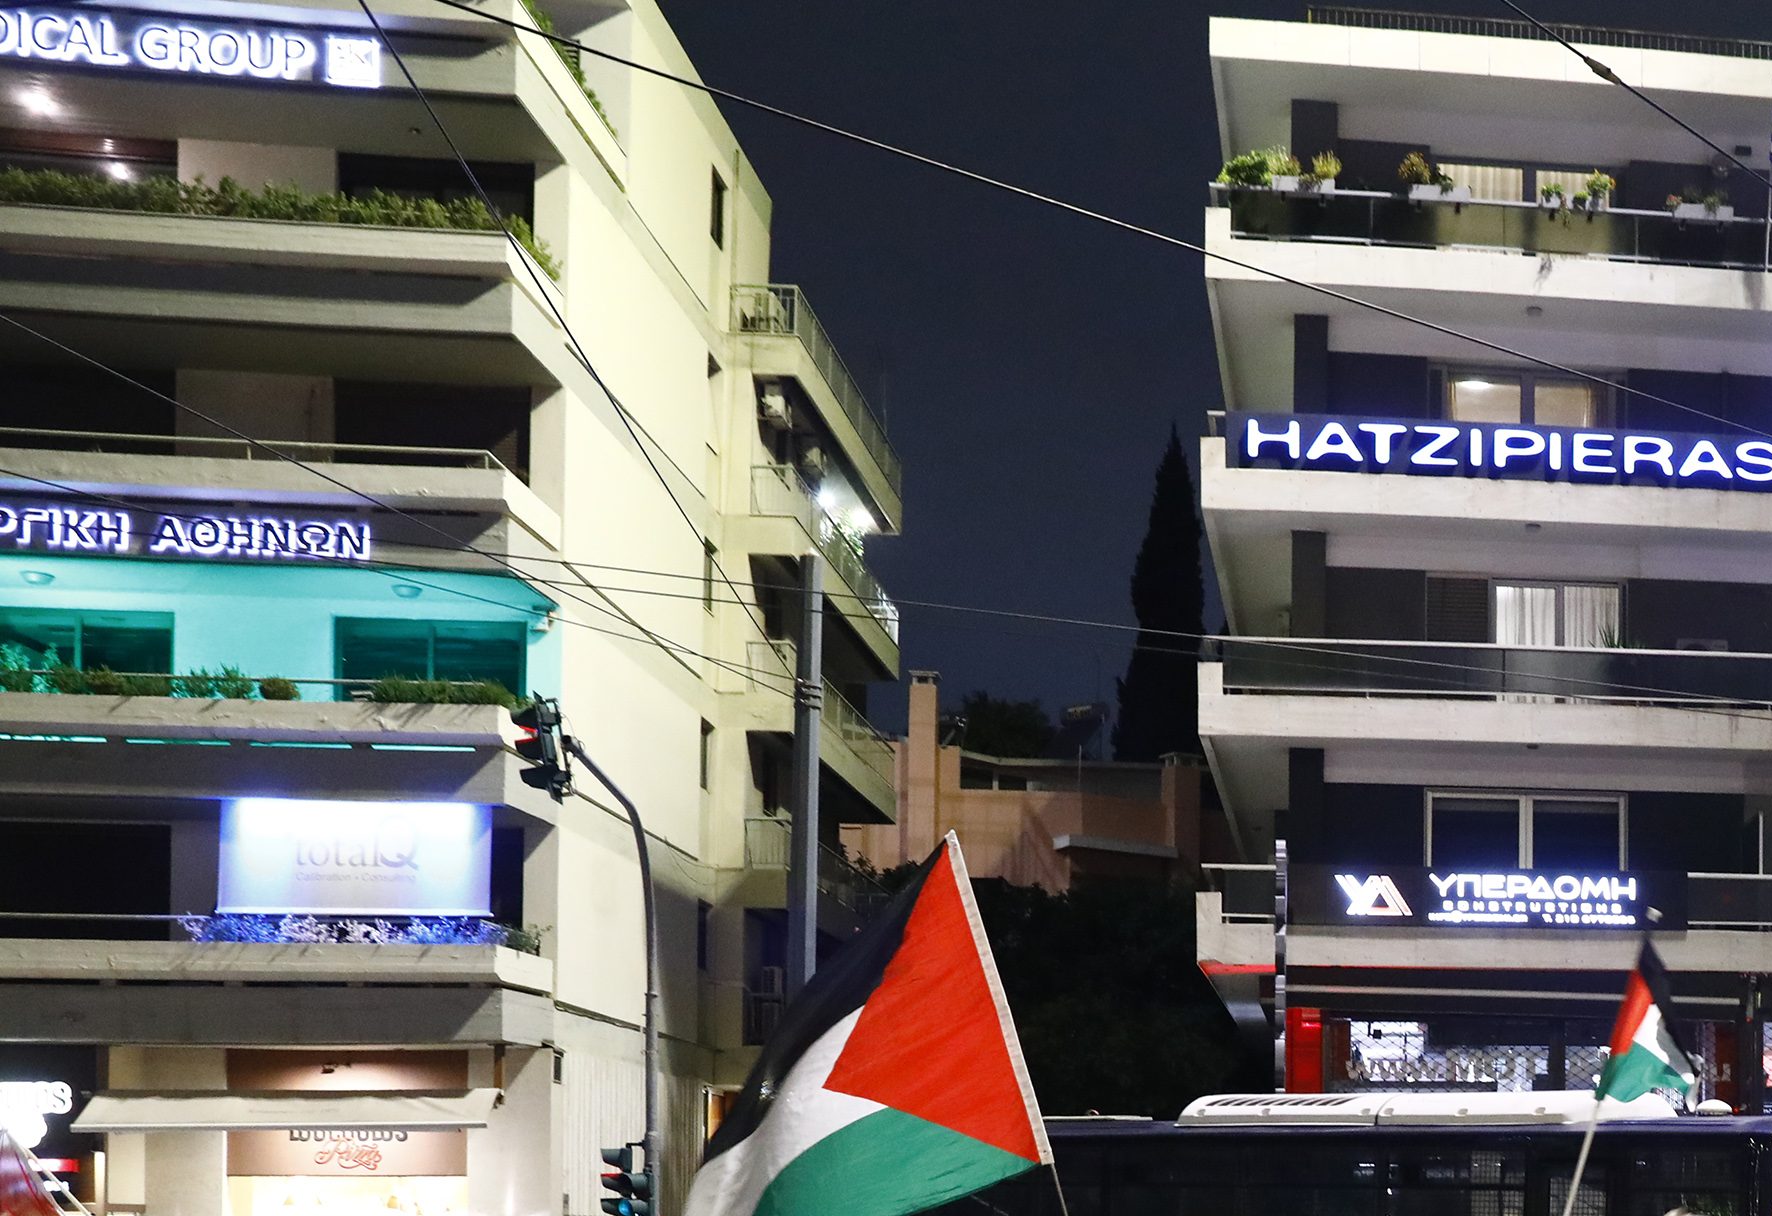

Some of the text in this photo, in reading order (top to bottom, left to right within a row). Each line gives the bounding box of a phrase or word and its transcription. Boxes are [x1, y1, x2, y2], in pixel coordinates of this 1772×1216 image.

[138, 26, 314, 78] GROUP
[150, 515, 373, 560] ΑΘΗΝΩΝ
[296, 872, 416, 883] Calibration Consulting
[1429, 872, 1636, 901] ΥΠΕΡΔΟΜΗ
[1443, 900, 1622, 914] CONSTRUCTIONS
